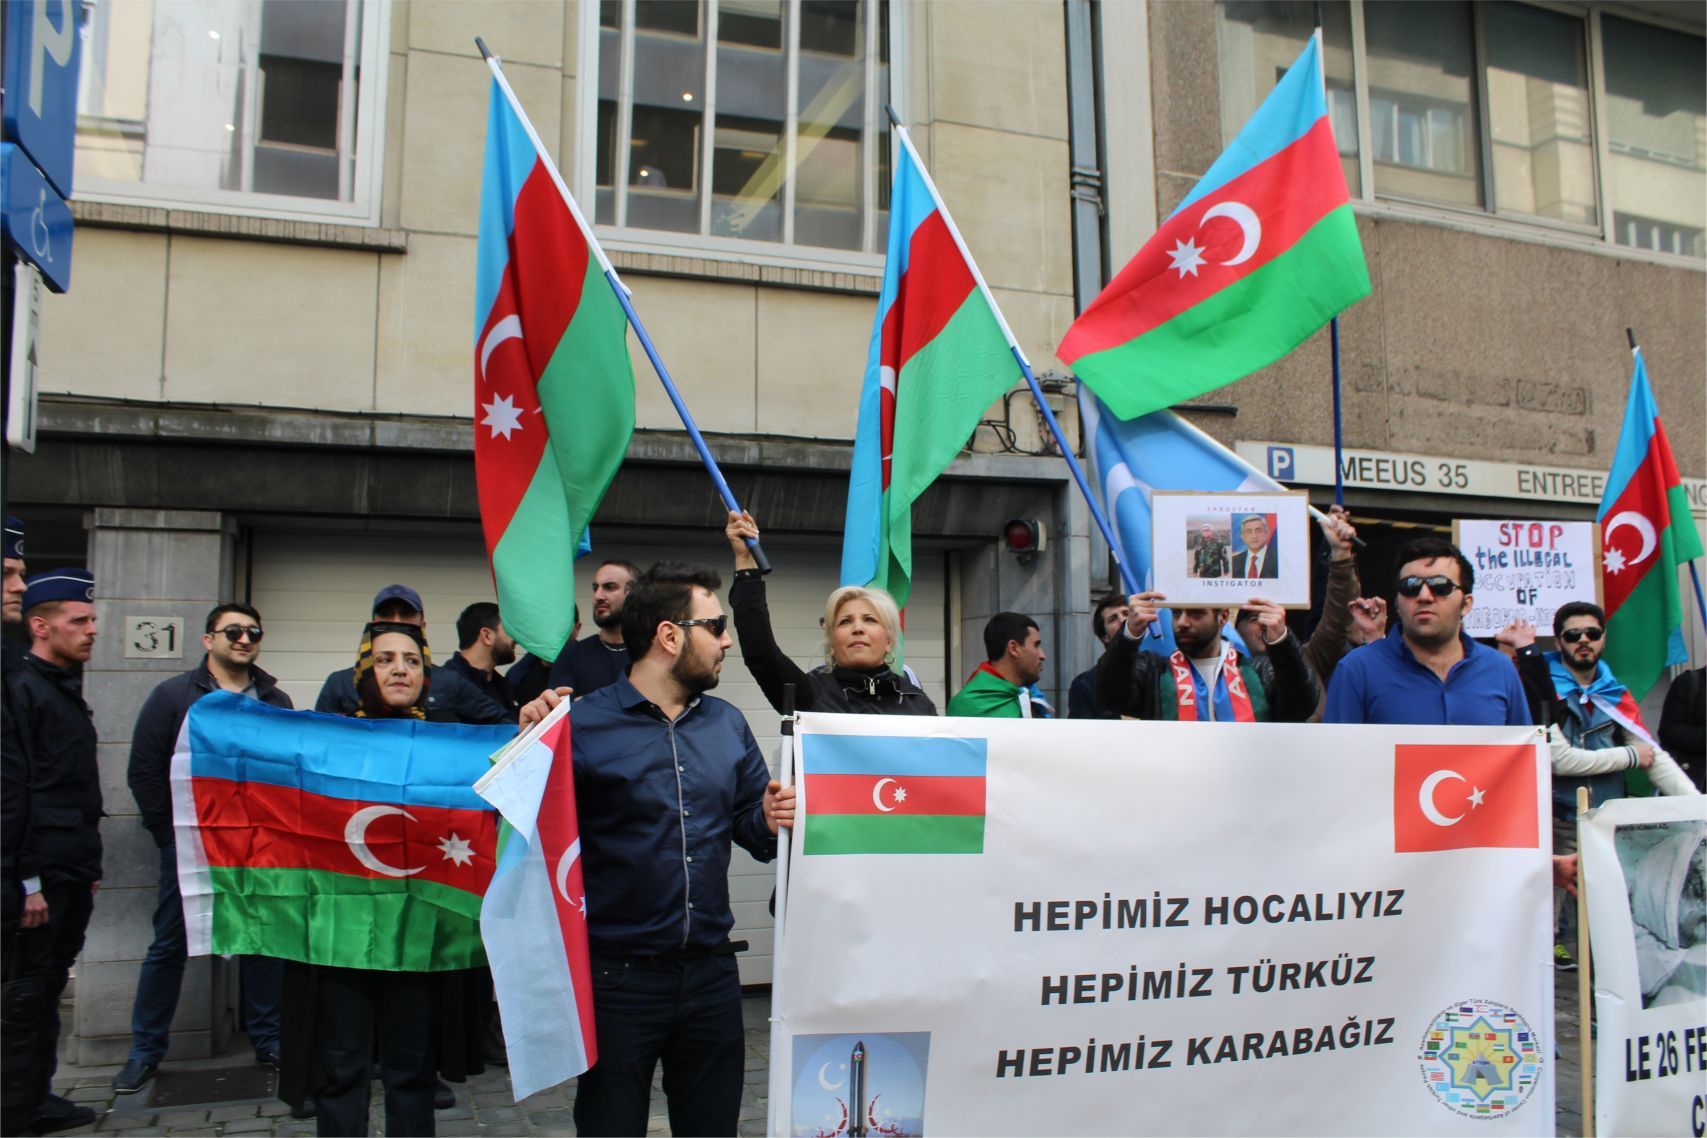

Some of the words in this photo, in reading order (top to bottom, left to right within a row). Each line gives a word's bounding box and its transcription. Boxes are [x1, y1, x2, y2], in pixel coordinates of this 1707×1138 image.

[28, 0, 74, 119] P
[1272, 450, 1291, 478] P
[1341, 456, 1427, 487] MEEUS
[1438, 463, 1469, 489] 35
[1517, 469, 1603, 499] ENTREE
[1498, 522, 1563, 550] STOP
[1475, 545, 1508, 570] the
[1202, 580, 1263, 588] INSTIGATOR
[1516, 588, 1538, 606] OF
[134, 621, 175, 652] 31
[1014, 891, 1190, 932] HEPİMİZ
[1204, 889, 1406, 926] HOCALIYIZ
[1041, 962, 1214, 1006] HEPİMİZ
[1226, 952, 1376, 995] TÜRKÜZ
[995, 1034, 1174, 1078] HEPİMİZ
[1186, 1015, 1396, 1066] KARABAĞIZ
[1625, 1035, 1651, 1083] LE
[1656, 1030, 1679, 1078] 26
